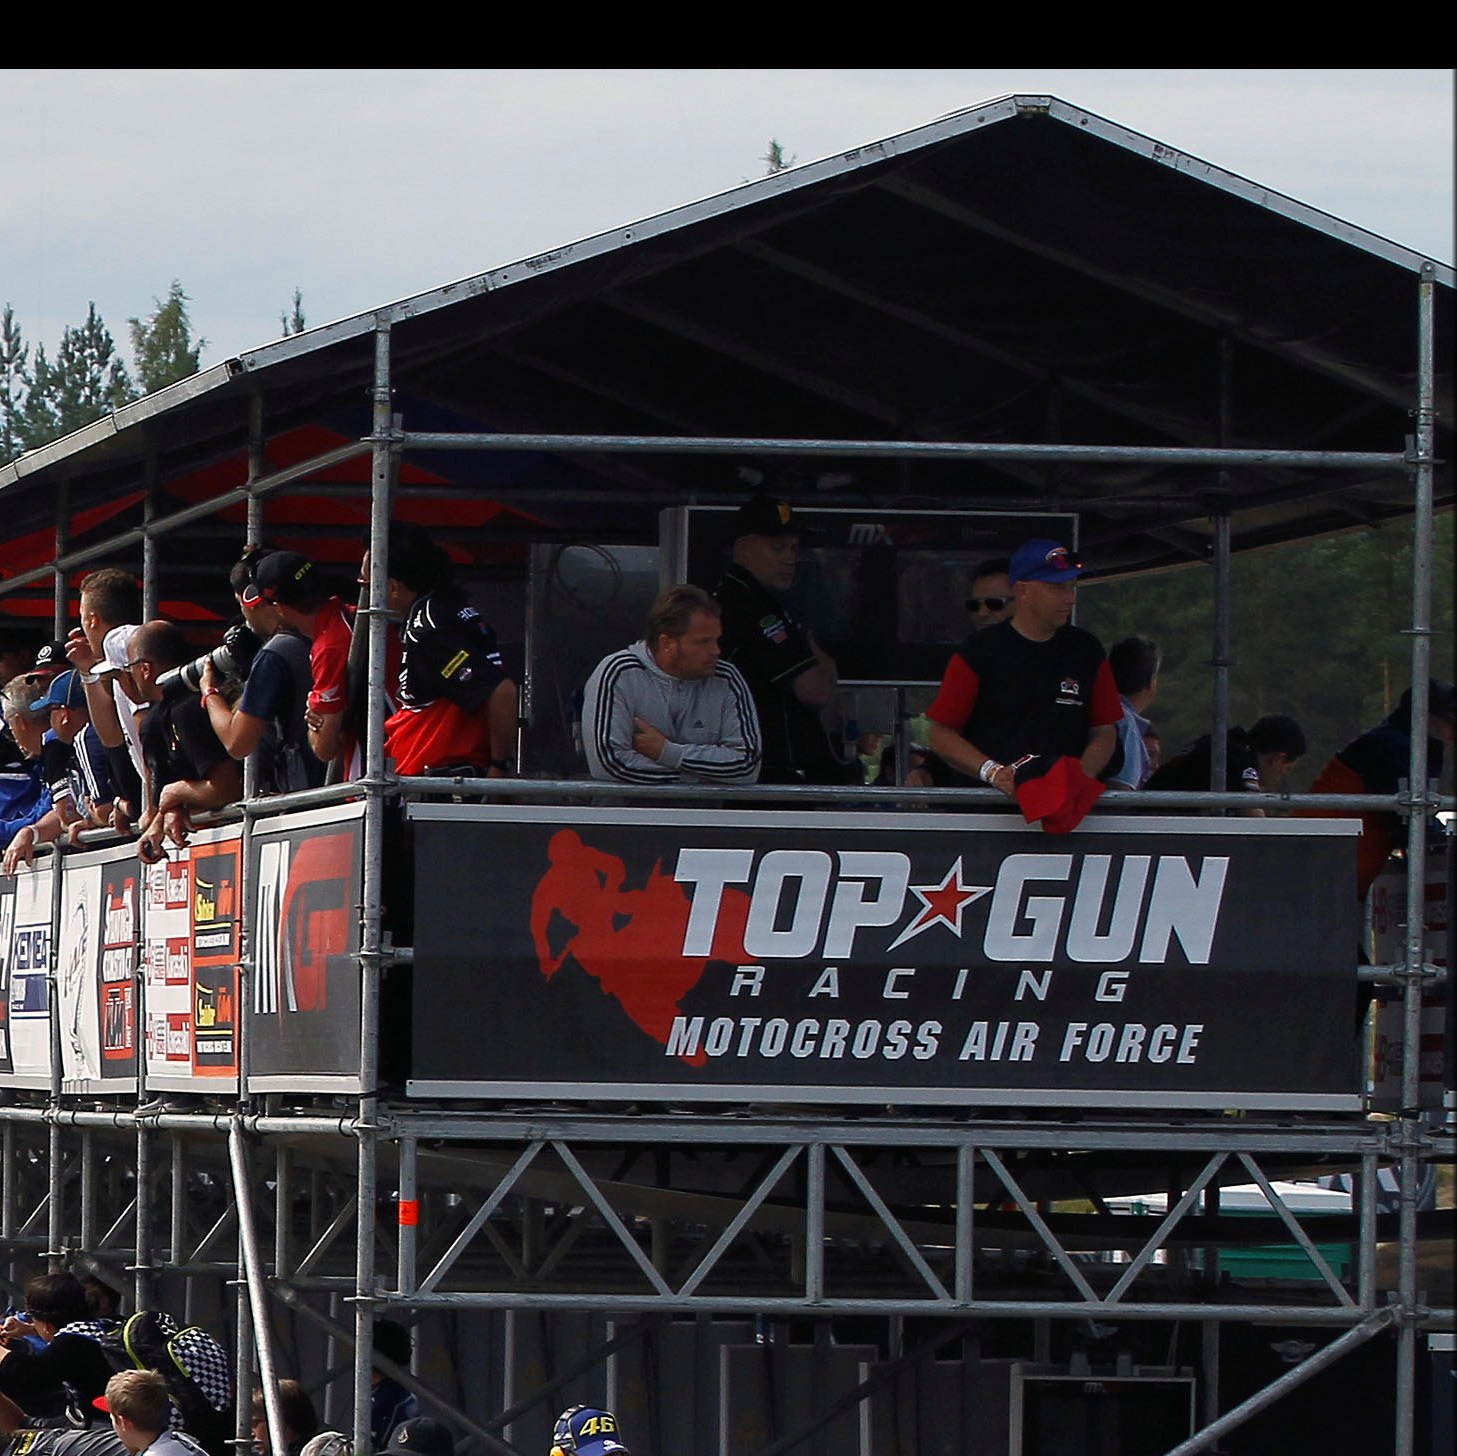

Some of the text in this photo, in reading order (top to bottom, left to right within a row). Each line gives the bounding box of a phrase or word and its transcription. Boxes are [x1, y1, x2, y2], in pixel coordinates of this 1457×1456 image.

[673, 848, 1231, 965] TOP GUN
[729, 964, 1131, 1003] RACING
[665, 1015, 1205, 1065] MOTOCROSS AIR FORCE
[579, 1416, 615, 1437] 46
